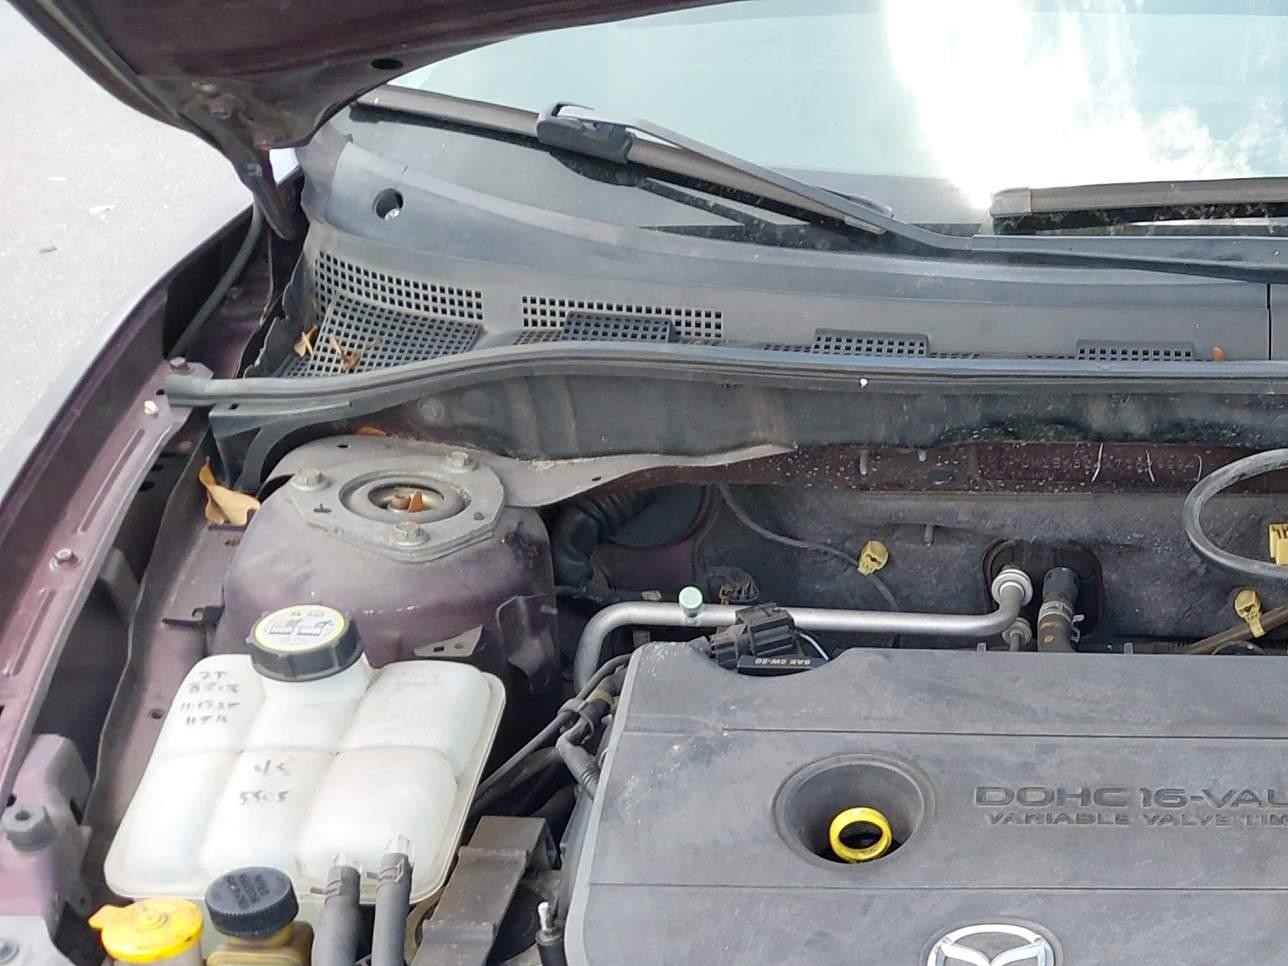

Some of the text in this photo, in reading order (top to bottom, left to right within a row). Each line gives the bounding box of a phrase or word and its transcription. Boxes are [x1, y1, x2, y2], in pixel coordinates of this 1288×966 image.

[974, 786, 1129, 807] DOHC
[988, 812, 1131, 825] VARIABLE
[1142, 813, 1233, 826] VALVE
